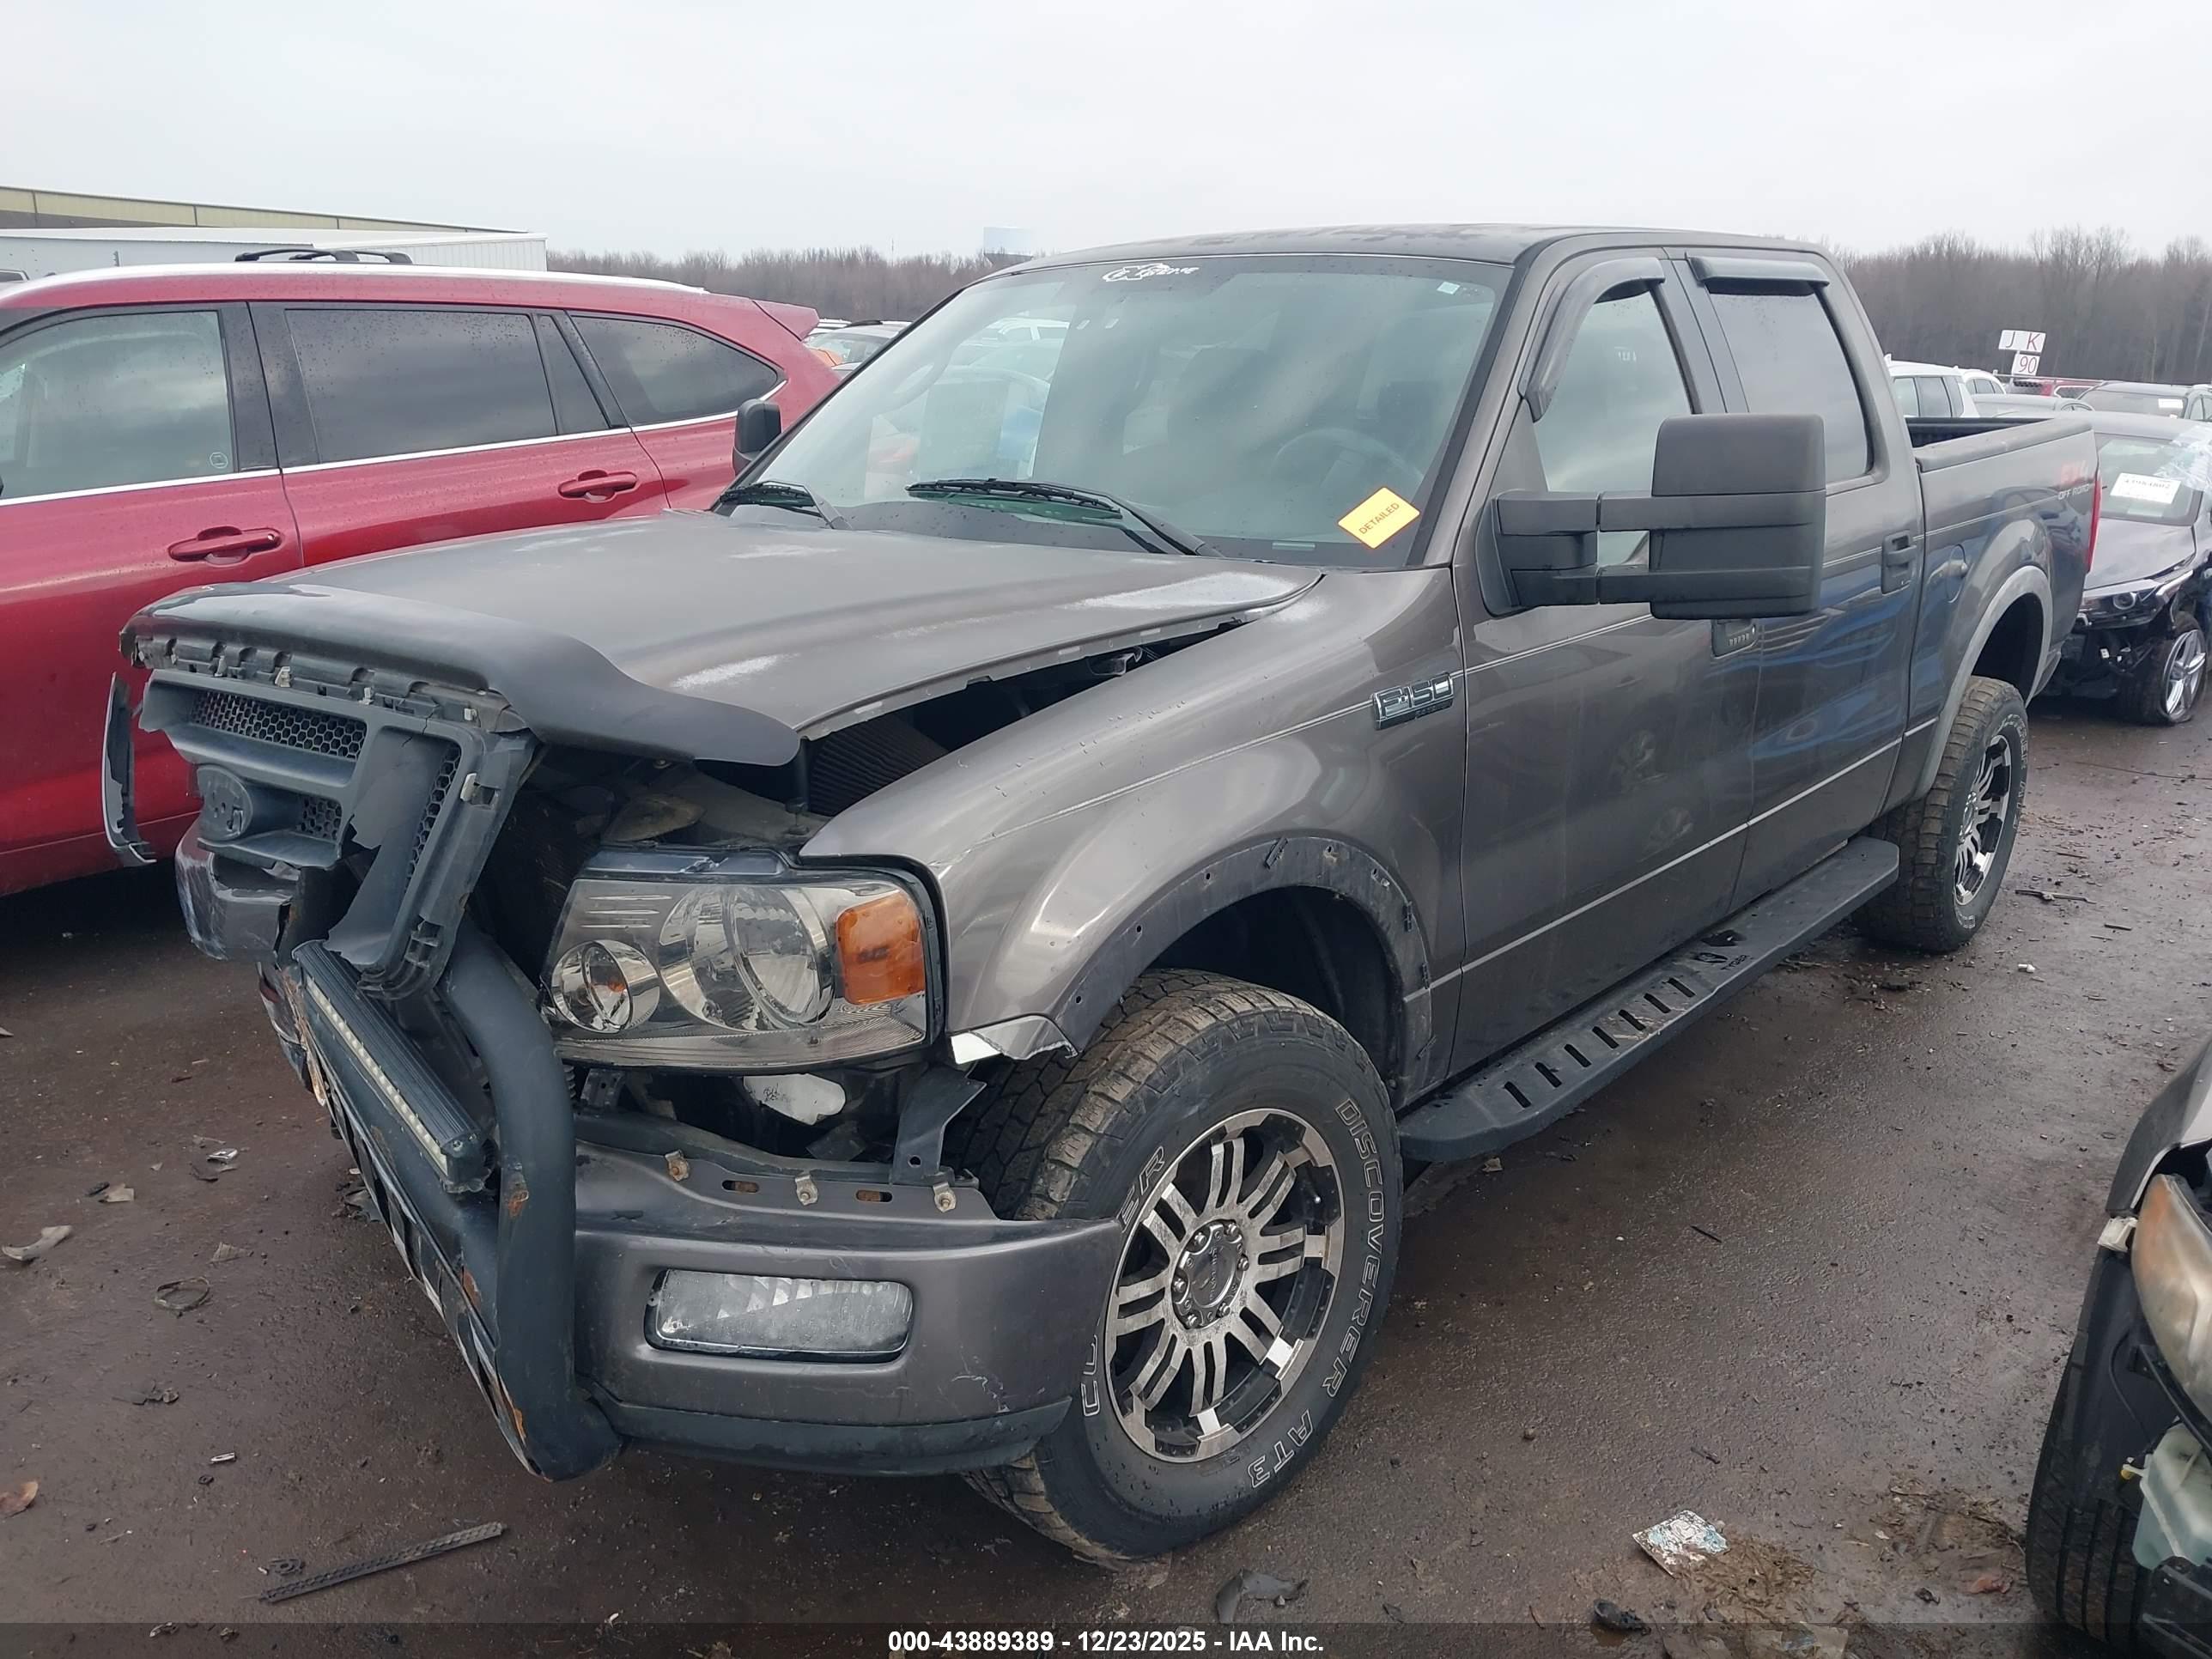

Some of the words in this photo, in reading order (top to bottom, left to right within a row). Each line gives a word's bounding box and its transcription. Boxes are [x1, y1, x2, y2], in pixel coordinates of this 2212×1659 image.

[2005, 331, 2016, 349] J
[2027, 332, 2040, 351] K
[2018, 356, 2038, 374] 90
[1358, 502, 1400, 535] DETAILED
[1321, 1098, 1385, 1400] DISCOVERER
[1247, 1408, 1316, 1489] AT3
